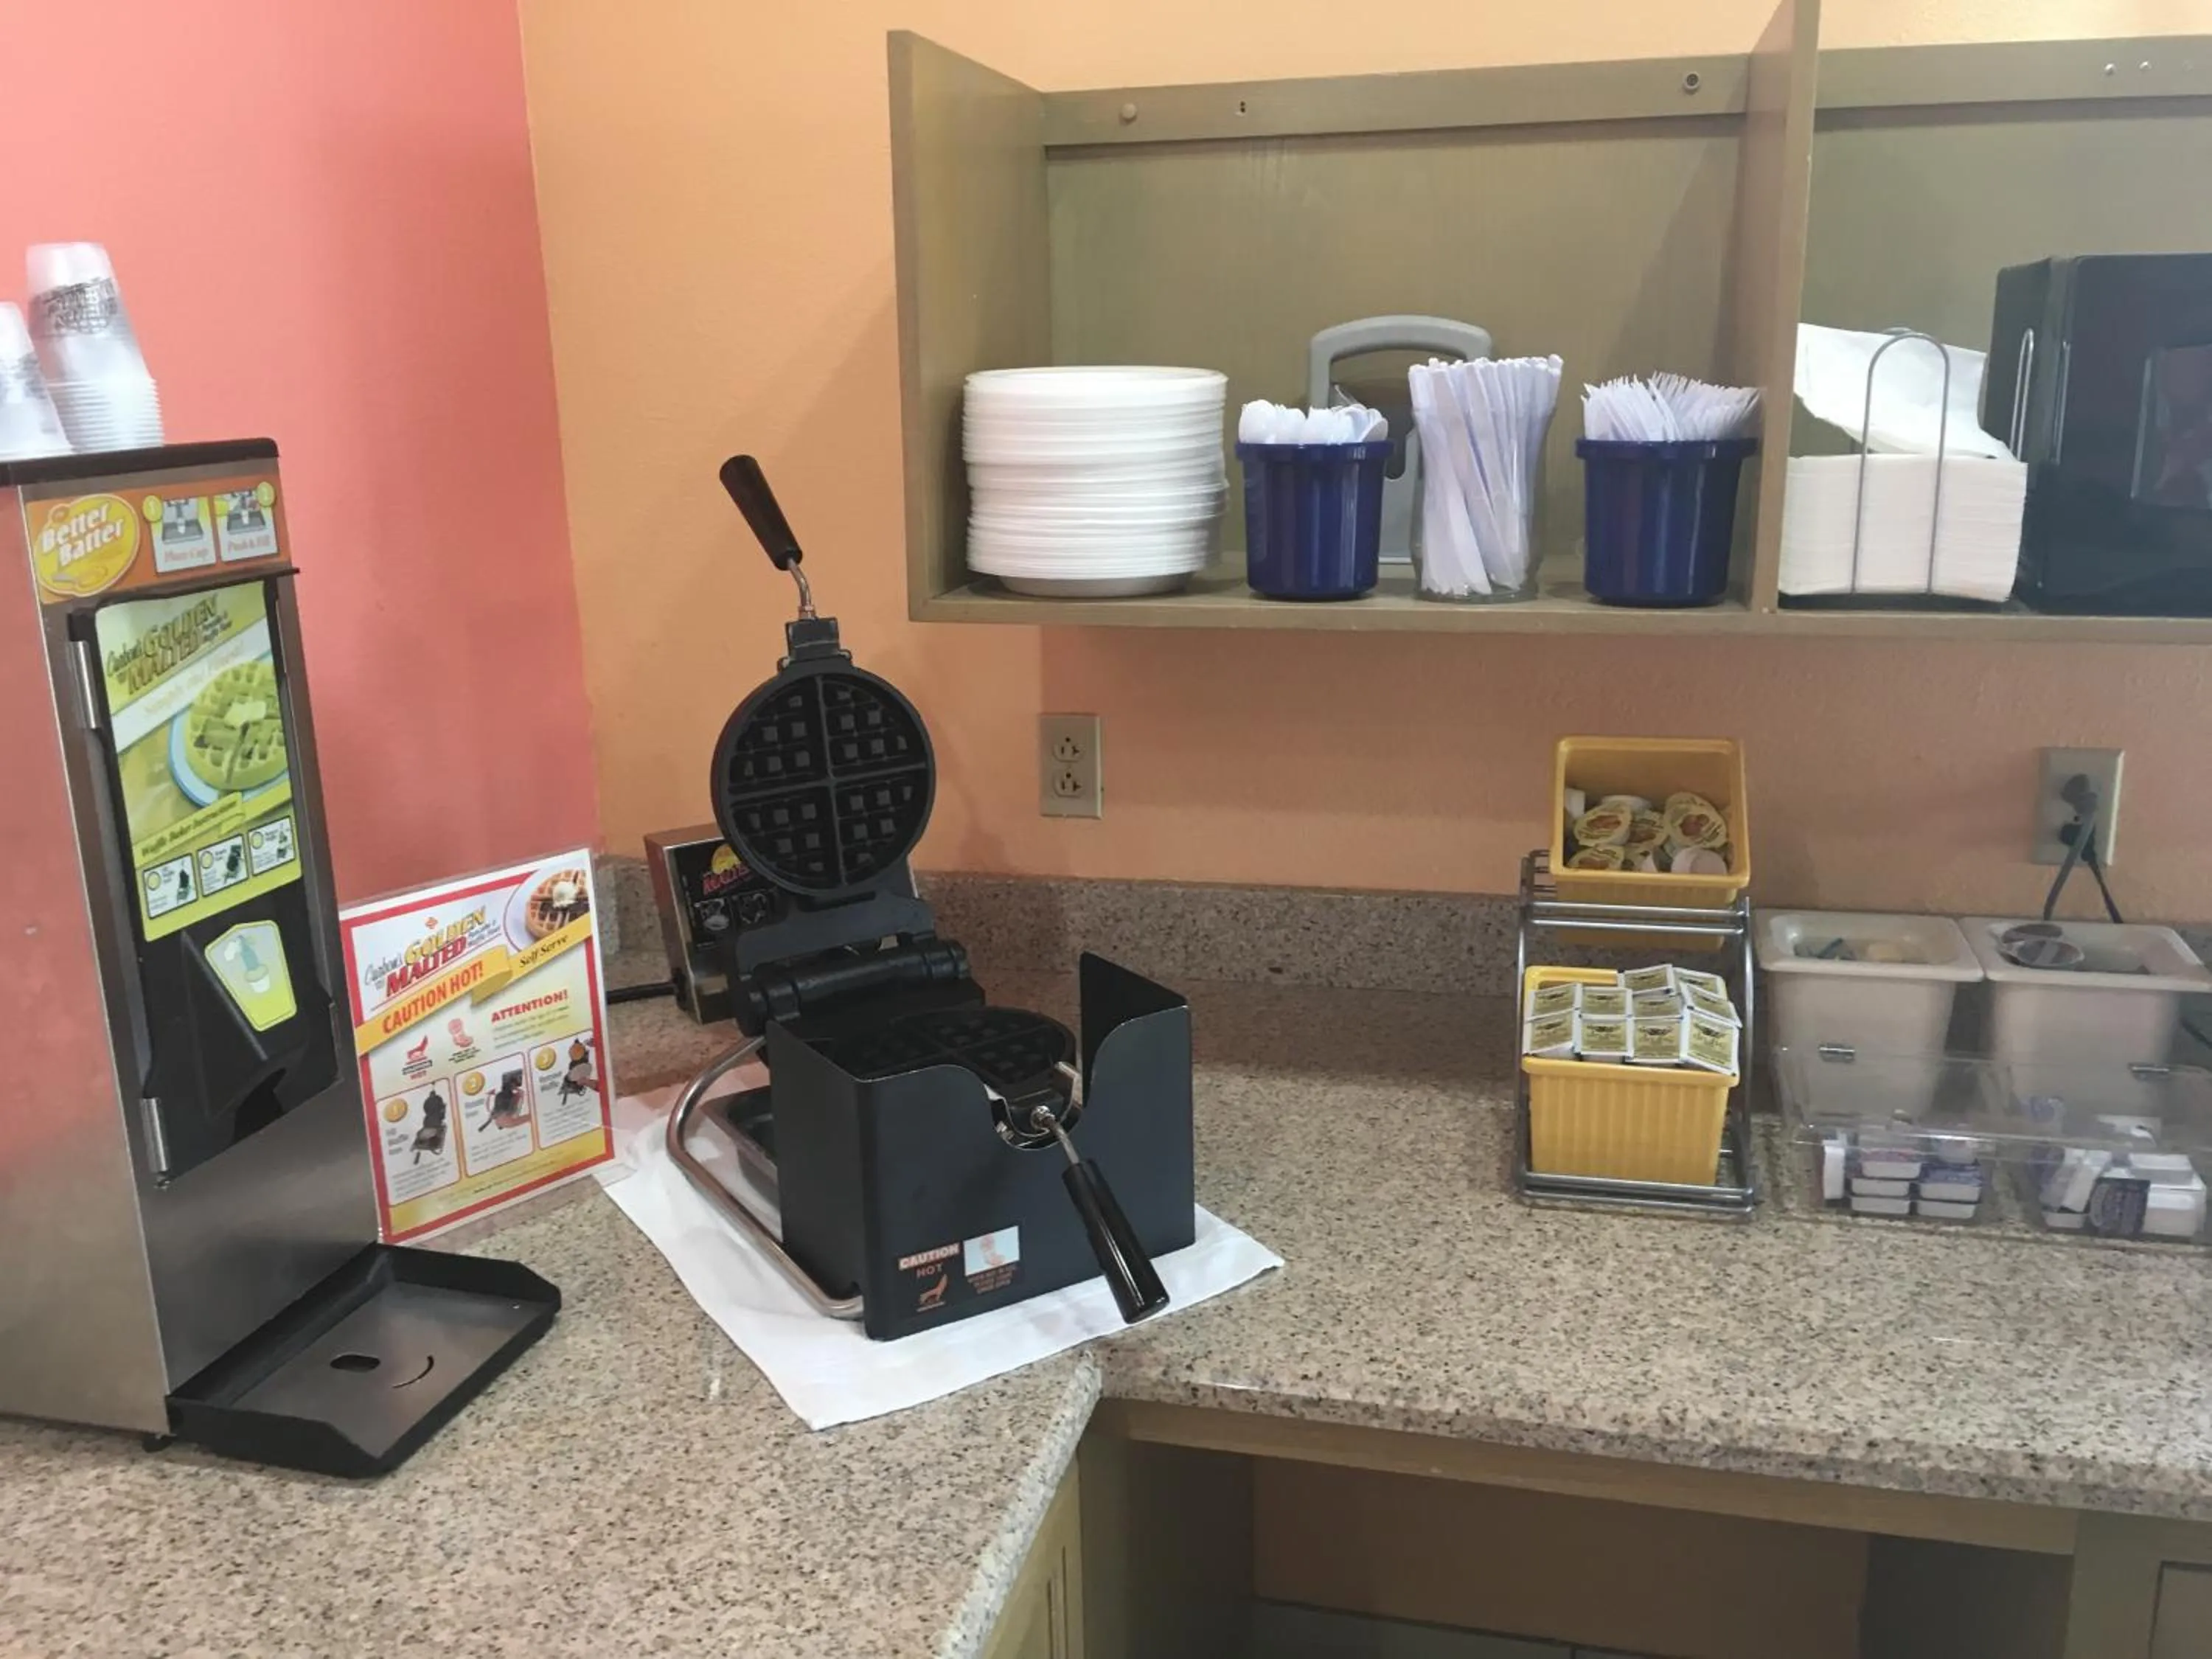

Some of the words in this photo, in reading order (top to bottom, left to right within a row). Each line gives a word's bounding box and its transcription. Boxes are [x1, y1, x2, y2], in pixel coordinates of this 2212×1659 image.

[41, 501, 109, 552] Better
[59, 518, 124, 567] Batter
[404, 905, 486, 965] GOLDEN
[519, 950, 539, 968] Self
[540, 934, 568, 953] Serve
[386, 936, 467, 997] MALTED
[383, 982, 447, 1034] CAUTION
[450, 960, 484, 995] HOT!
[491, 989, 568, 1023] ATTENTION!
[900, 1243, 959, 1268] CAUTION
[917, 1263, 943, 1279] HOT
